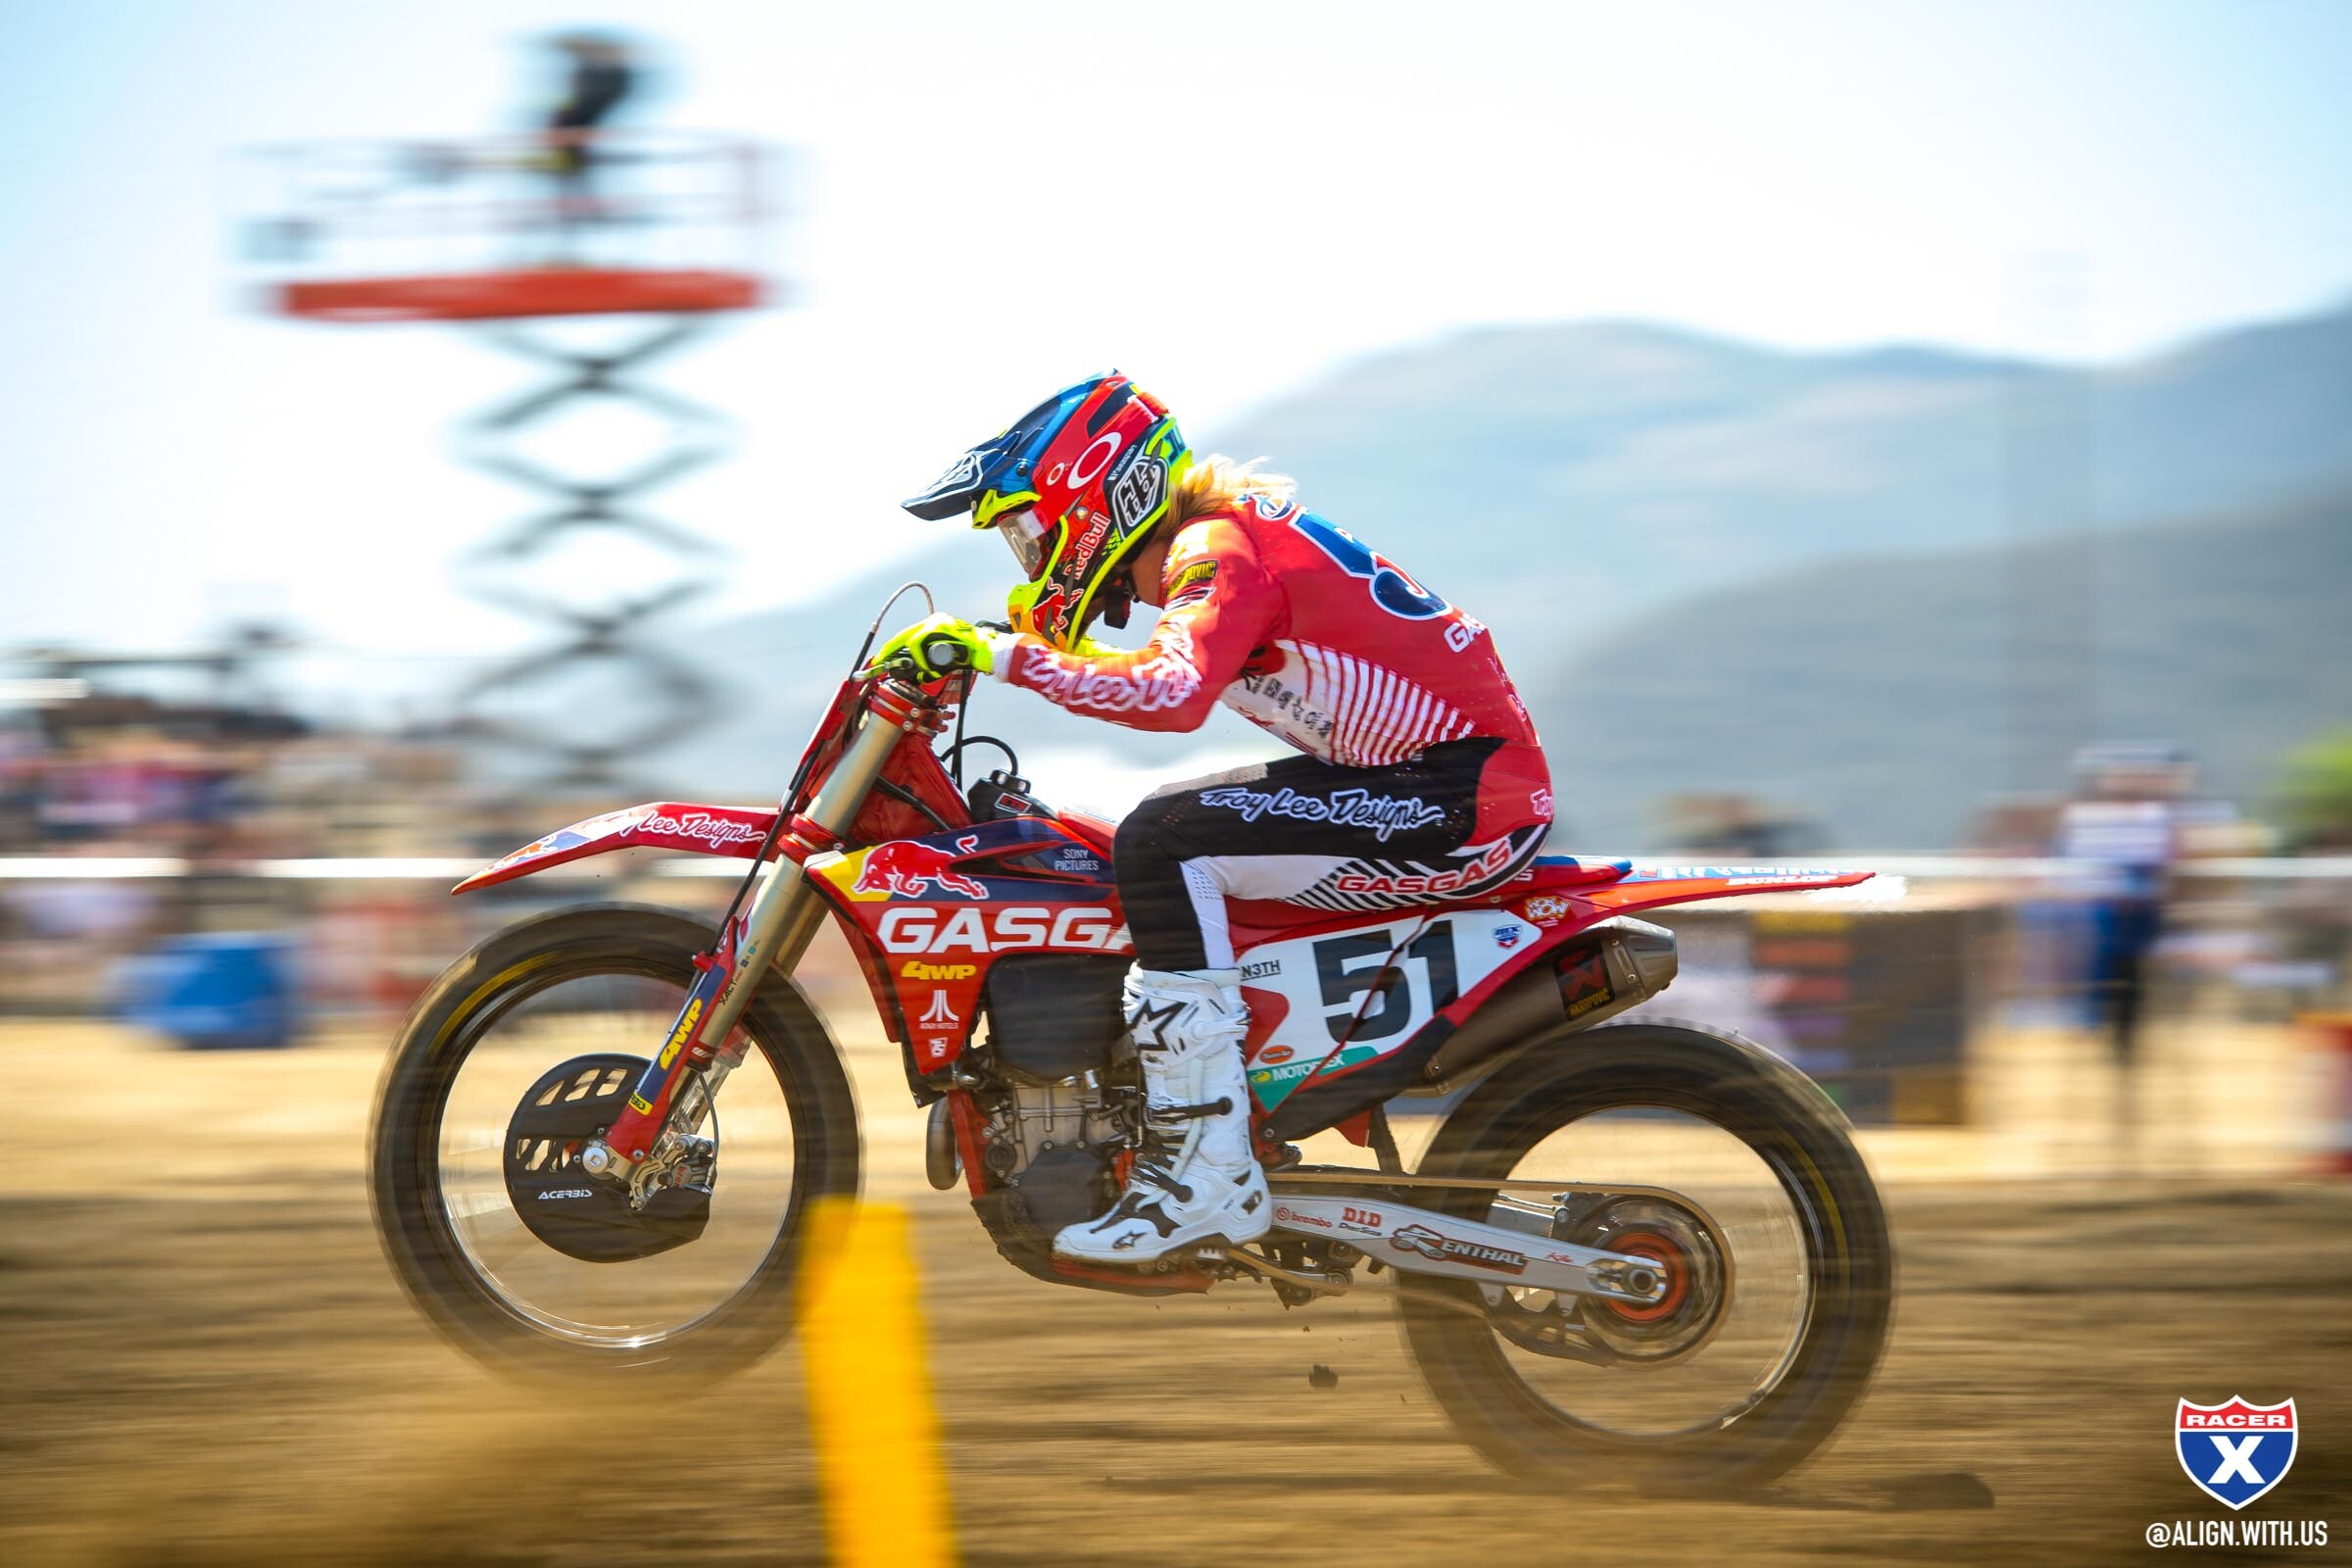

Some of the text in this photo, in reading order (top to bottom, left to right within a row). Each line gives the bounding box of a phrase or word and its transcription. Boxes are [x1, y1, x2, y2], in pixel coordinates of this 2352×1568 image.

[1200, 787, 1446, 843] Troy Lee Designs
[637, 810, 679, 834] Lee
[677, 812, 766, 849] Designs
[1054, 859, 1100, 871] PICTURES
[1062, 848, 1089, 859] SONY
[1336, 837, 1513, 895] GASGAS
[1313, 920, 1459, 1044] 51
[538, 1189, 593, 1200] ACERBIS
[1292, 1211, 1333, 1228] brembo
